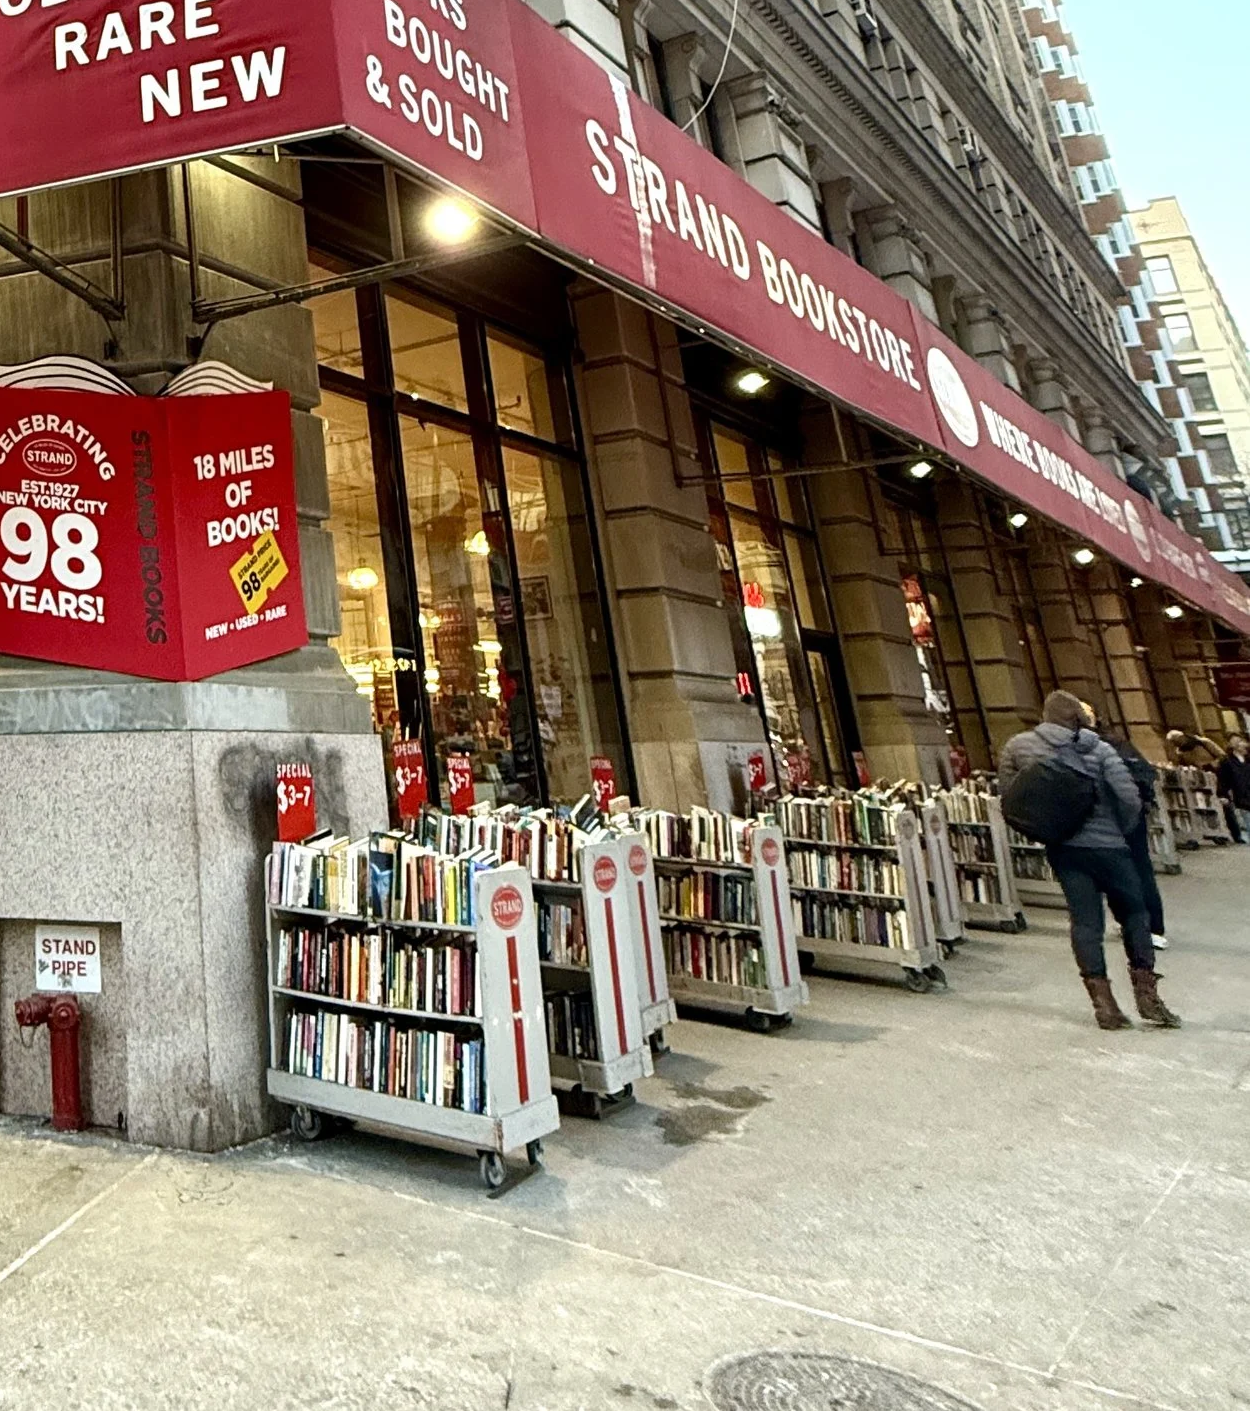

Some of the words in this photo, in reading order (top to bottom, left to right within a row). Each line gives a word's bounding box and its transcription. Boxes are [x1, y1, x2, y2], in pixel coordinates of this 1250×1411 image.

[140, 46, 286, 123] NEW
[365, 54, 393, 108] &
[400, 81, 485, 162] SOLD
[584, 118, 751, 282] STRAND
[757, 240, 922, 393] BOOKSTORE
[27, 450, 73, 465] STRAND
[193, 454, 216, 481] 18
[219, 444, 275, 474] MILES
[131, 430, 158, 542] STRAND
[224, 479, 253, 508] OF
[31, 495, 71, 512] YORK
[74, 498, 108, 516] CITY
[206, 506, 280, 548] BOOKS!
[0, 506, 103, 591] 98
[0, 581, 106, 624] YEARS!
[139, 545, 168, 646] BOOKS
[241, 571, 261, 602] 98
[205, 621, 228, 641] NEW
[235, 612, 260, 631] USED
[264, 604, 288, 622] RARE
[393, 741, 422, 756] SPECIAL
[447, 757, 471, 769] SPECIAL
[276, 763, 312, 779] SPECIAL
[395, 766, 423, 796] $3-7
[448, 768, 471, 796] $3-7
[276, 780, 311, 815] $3-7
[41, 938, 97, 956] STAND
[51, 960, 88, 977] PIPE
